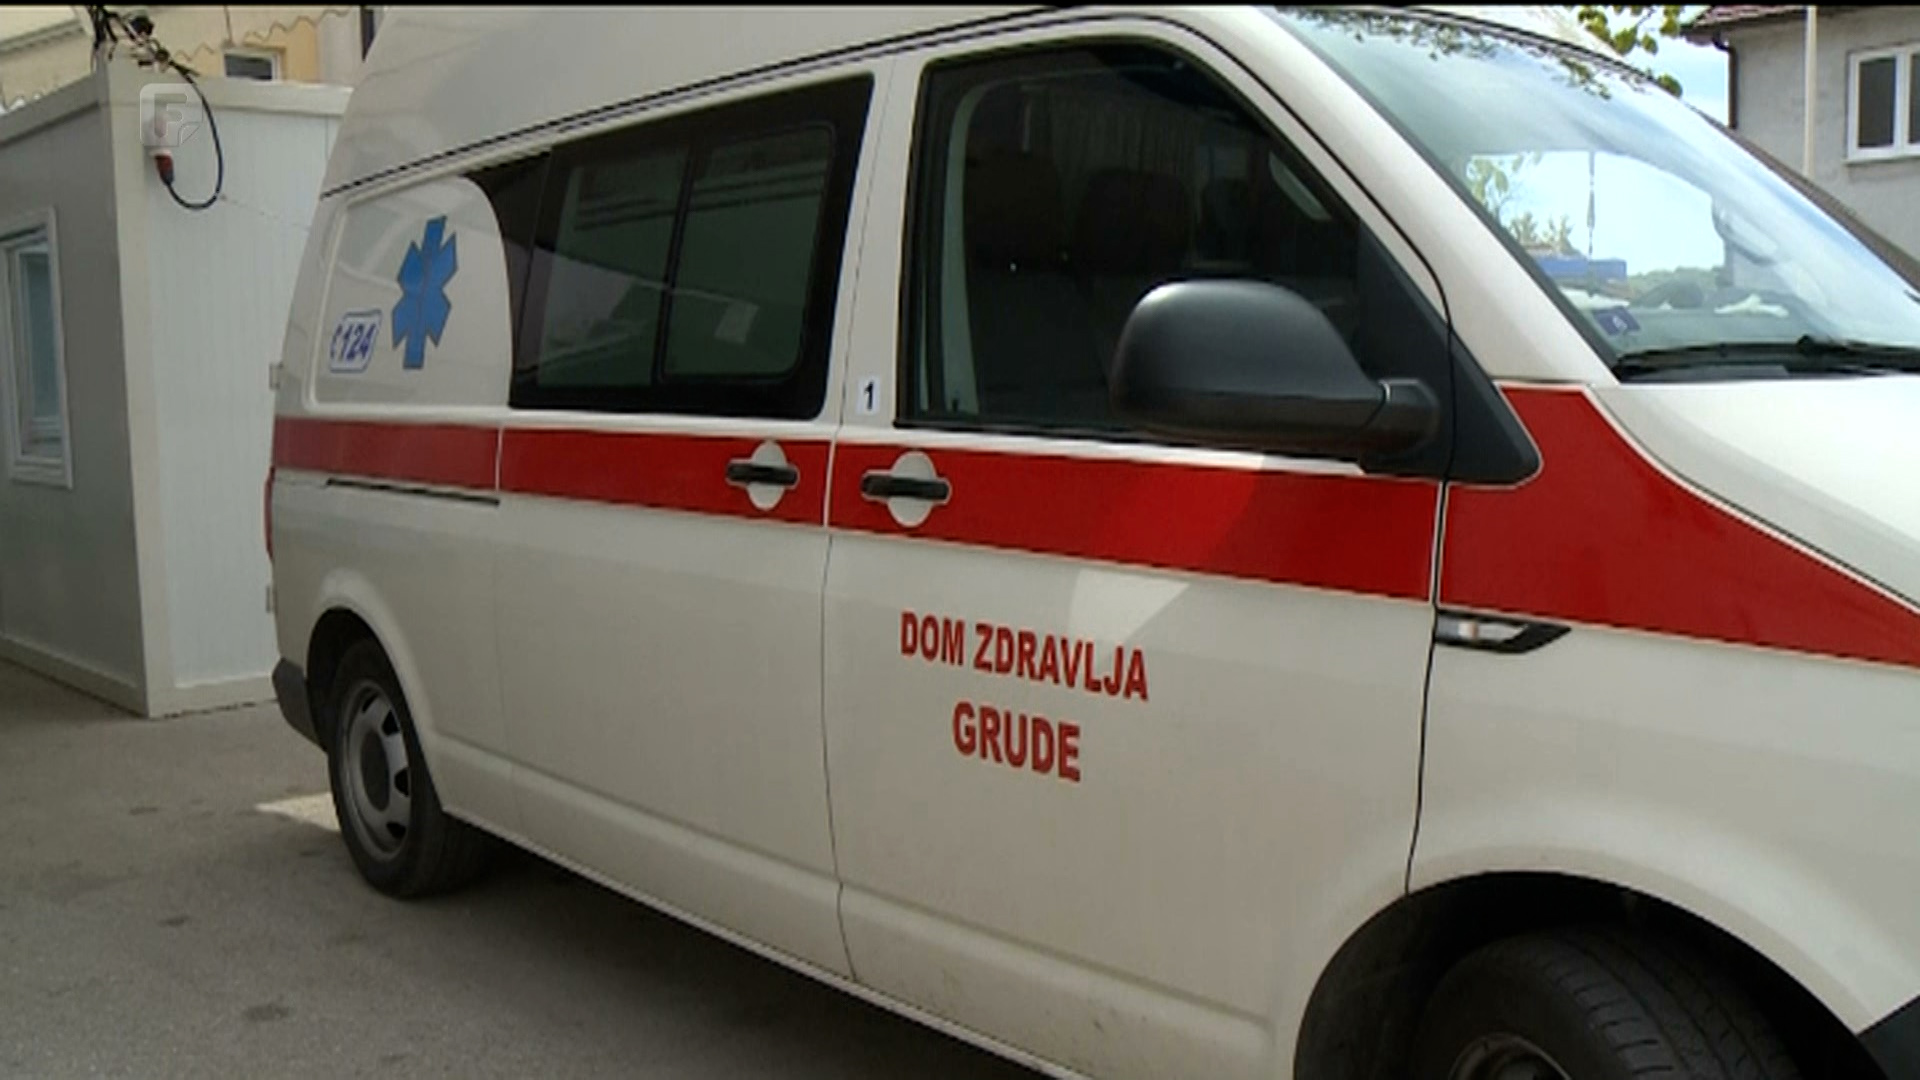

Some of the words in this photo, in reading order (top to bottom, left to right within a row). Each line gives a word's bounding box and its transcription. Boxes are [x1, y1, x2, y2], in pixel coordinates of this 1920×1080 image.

[339, 323, 377, 362] 124
[863, 381, 875, 411] 1
[900, 610, 965, 667] DOM
[973, 622, 1149, 702] ZDRAVLJA
[952, 700, 1082, 783] GRUDE
